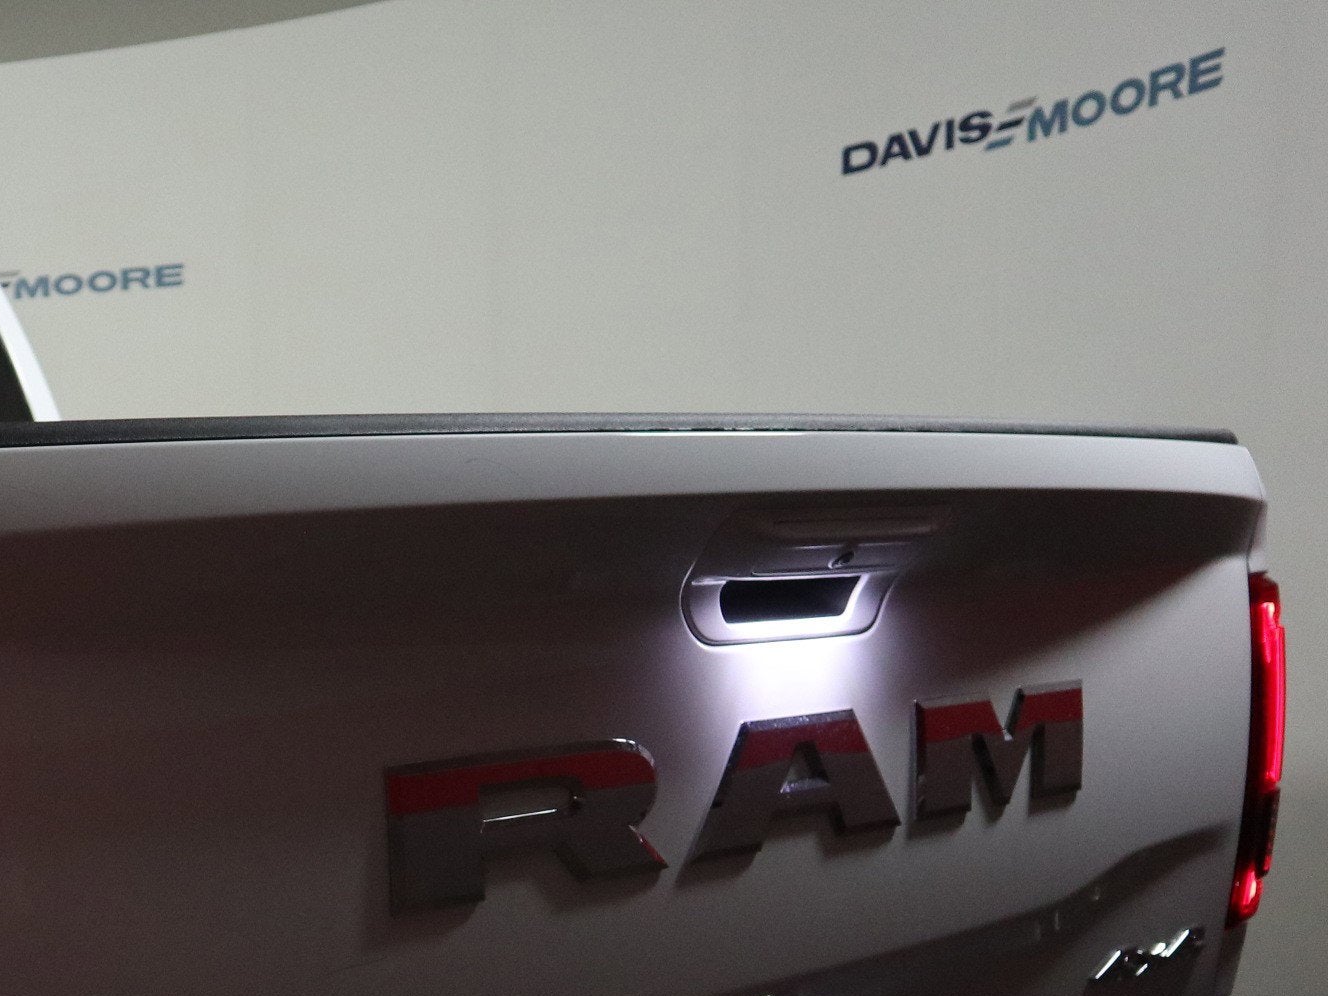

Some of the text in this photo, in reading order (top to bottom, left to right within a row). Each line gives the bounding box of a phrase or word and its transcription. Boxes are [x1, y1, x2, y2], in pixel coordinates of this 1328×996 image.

[841, 46, 1227, 176] DAVIS MOORE
[14, 263, 184, 299] MOORE
[386, 680, 1084, 916] RAM
